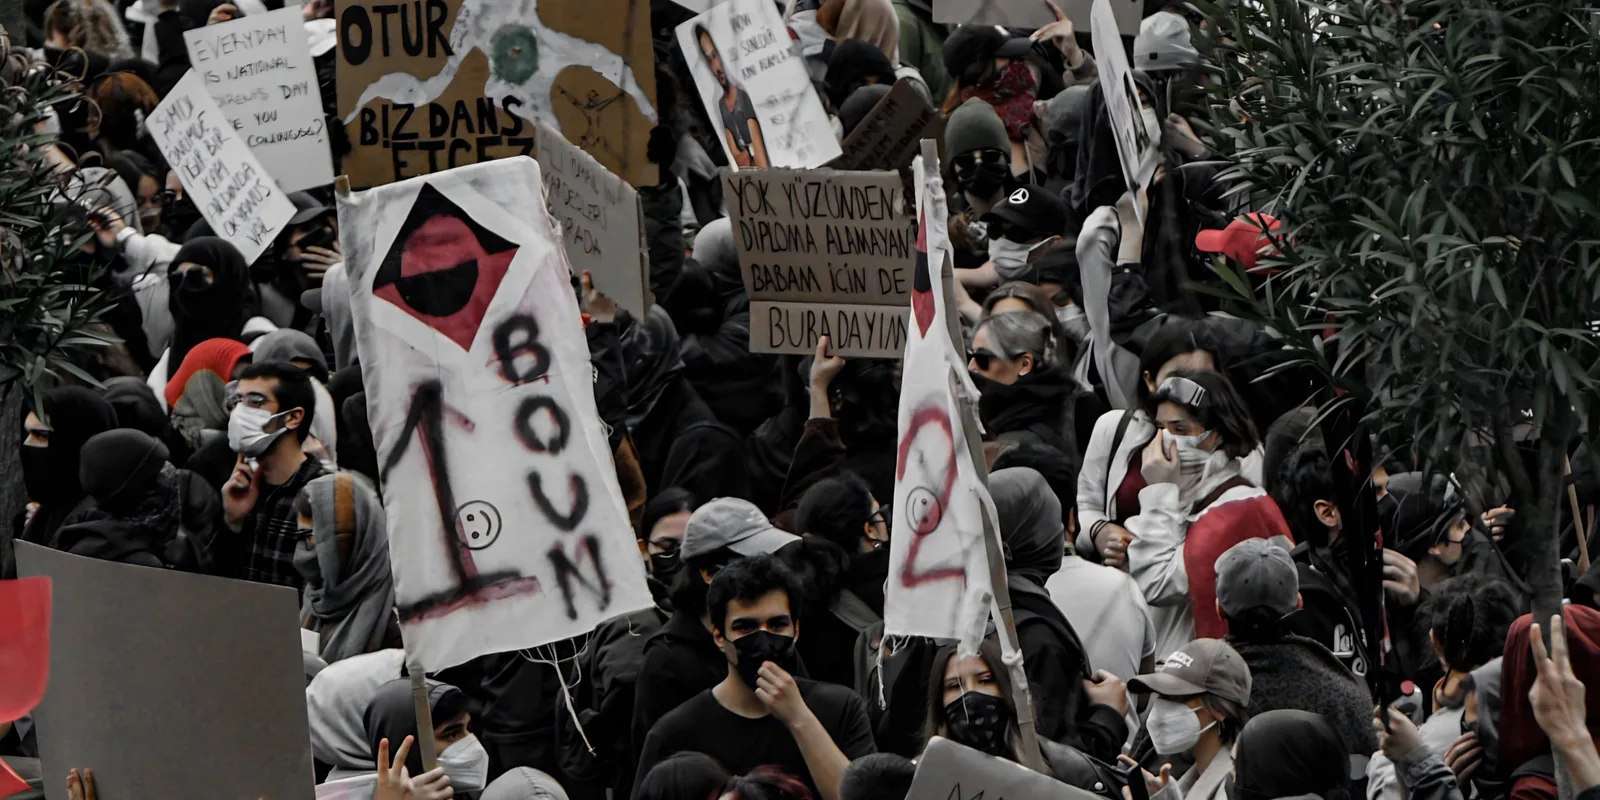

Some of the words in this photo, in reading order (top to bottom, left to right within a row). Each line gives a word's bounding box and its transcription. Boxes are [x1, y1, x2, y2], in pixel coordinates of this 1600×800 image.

[194, 25, 286, 61] EVERYDAY
[340, 0, 455, 65] OTUR
[279, 82, 308, 100] DAY
[253, 110, 278, 126] YOU
[429, 95, 523, 138] DANS
[728, 176, 777, 217] YÖK
[782, 176, 895, 221] YÜZÜNDEN
[739, 218, 818, 253] DİPLOMA
[826, 224, 910, 259] ALAMAYAN
[751, 264, 822, 292] BABAM
[827, 262, 866, 295] İÇİN
[878, 268, 907, 295] DE
[896, 406, 967, 588] 2
